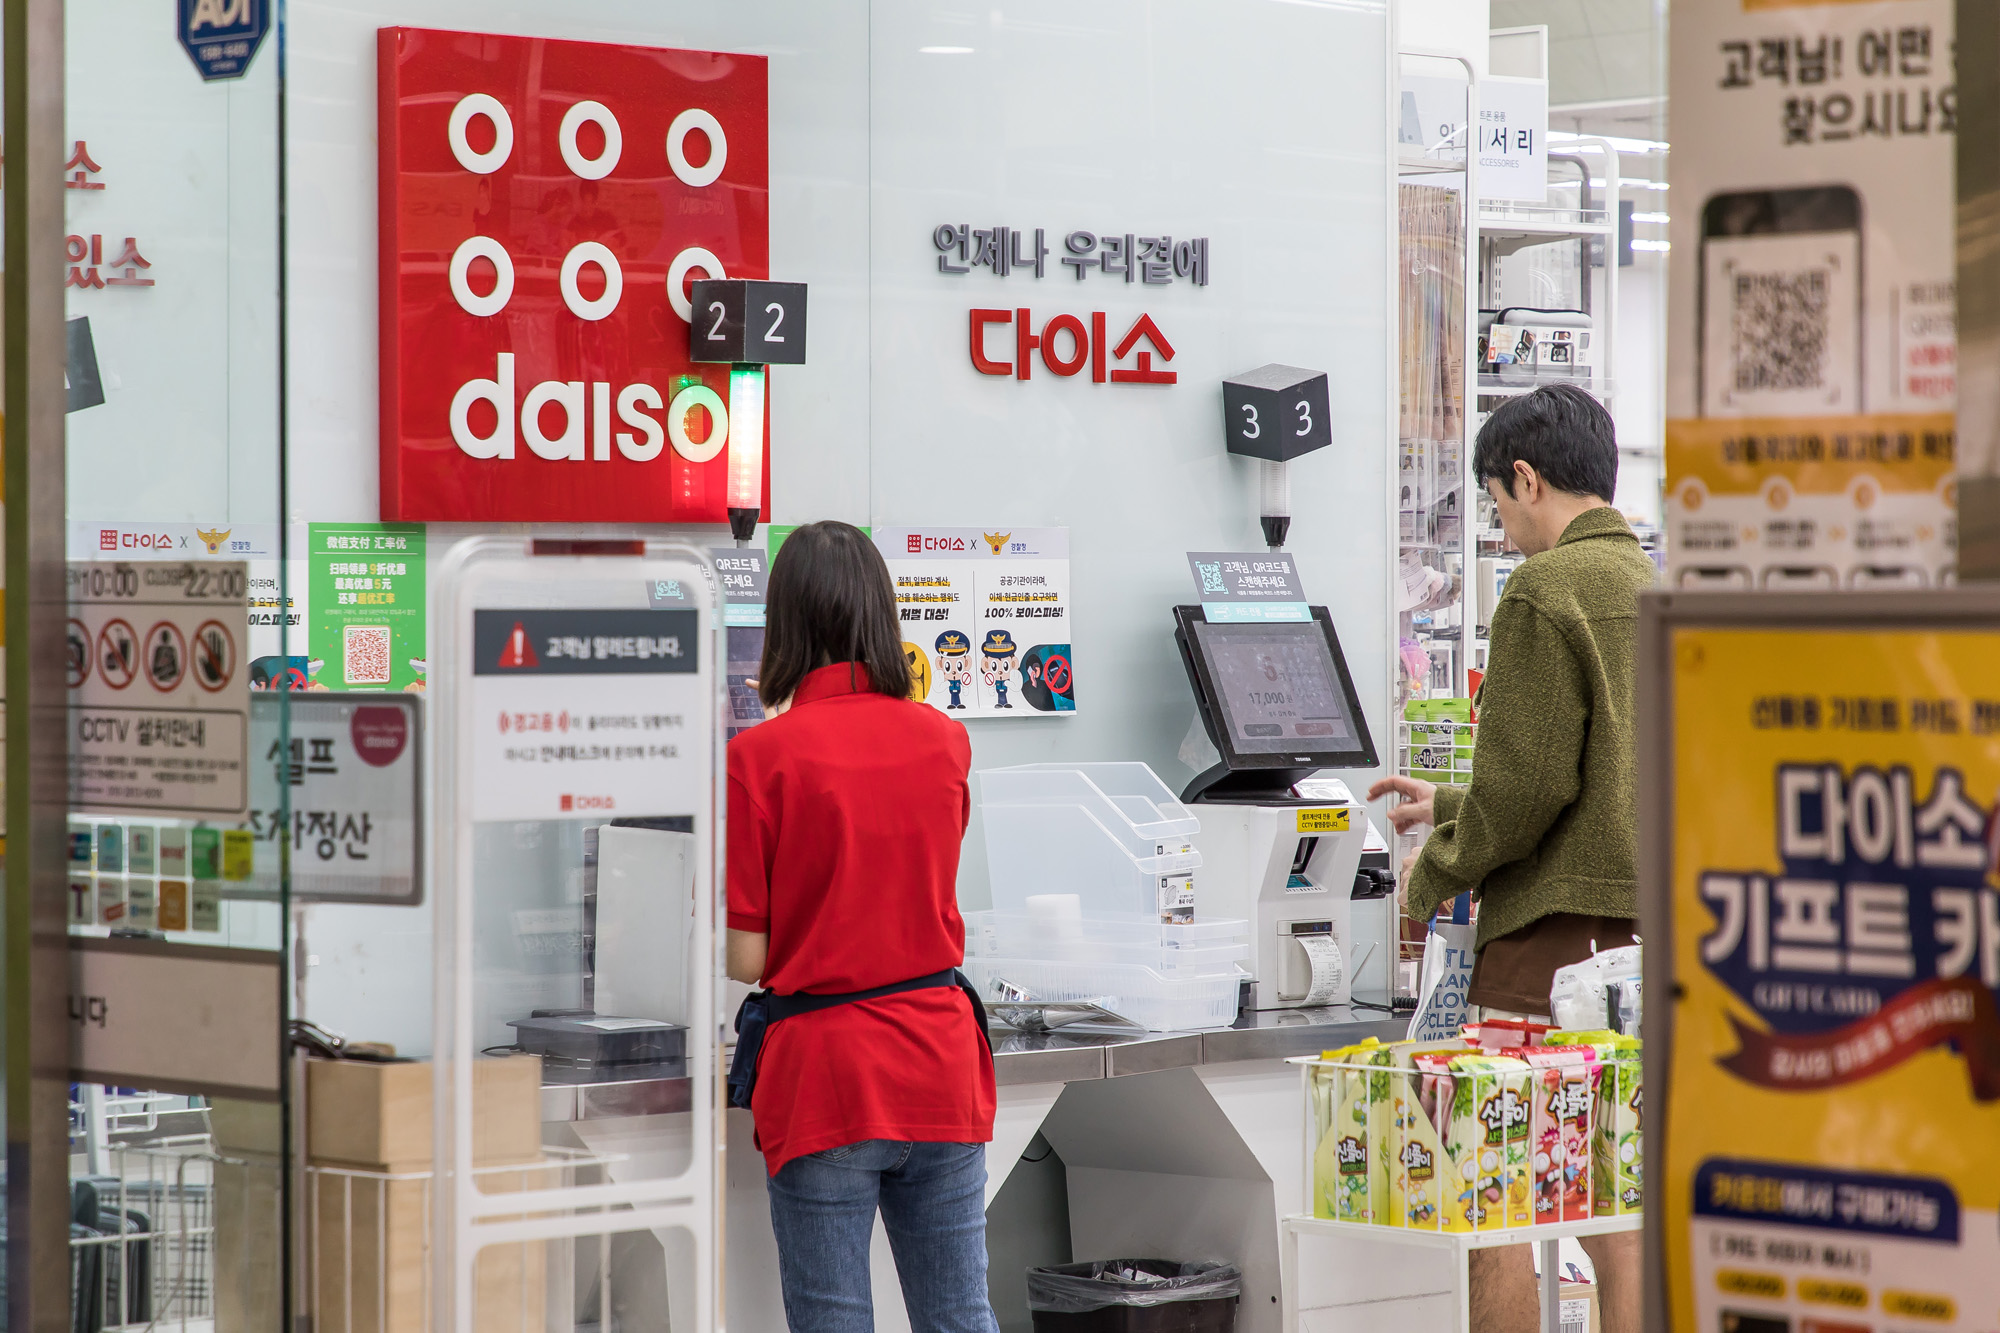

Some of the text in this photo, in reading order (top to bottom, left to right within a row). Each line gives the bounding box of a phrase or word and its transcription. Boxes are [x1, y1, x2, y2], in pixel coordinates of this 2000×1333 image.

[1719, 26, 1932, 89] 고객님! 어떤
[1494, 110, 1505, 122] 용품
[933, 223, 1209, 287] 언제나 우리곁에
[707, 301, 726, 341] 2
[764, 303, 784, 342] 2
[969, 307, 1178, 384] 다이소
[449, 352, 729, 463] daiso
[1242, 404, 1260, 438] 3
[1295, 401, 1312, 436] 3
[122, 533, 172, 549] 다이소
[230, 541, 251, 551] 경찰청
[326, 536, 407, 549] 微信支付 汇率优
[924, 537, 965, 551] 다이소
[1011, 543, 1027, 551] 경찰청
[716, 558, 760, 573] QR코드를
[1223, 561, 1291, 574] 고객님, QR코드를
[82, 567, 139, 598] 10:00
[184, 567, 247, 598] 22:00
[1000, 575, 1047, 587] 공공기관이라며,
[1238, 576, 1287, 588] 스캔해주세요
[895, 593, 910, 602] 건을
[940, 592, 960, 602] 행위도
[1032, 592, 1058, 602] 요구하면
[900, 608, 949, 620] 처벌 대상!
[984, 607, 1064, 618] 100% 보이스피싱!
[546, 636, 684, 659] 고객님 알려드립니다.
[1248, 692, 1285, 705] 17,000
[514, 711, 553, 733] 경고음
[79, 718, 205, 748] CCTV 설치안내
[266, 738, 338, 786] 셀프
[1413, 751, 1448, 768] eclipse
[576, 796, 615, 809] 다이소
[1779, 767, 1987, 869] 다이소
[1703, 876, 2000, 987] 기프트 카
